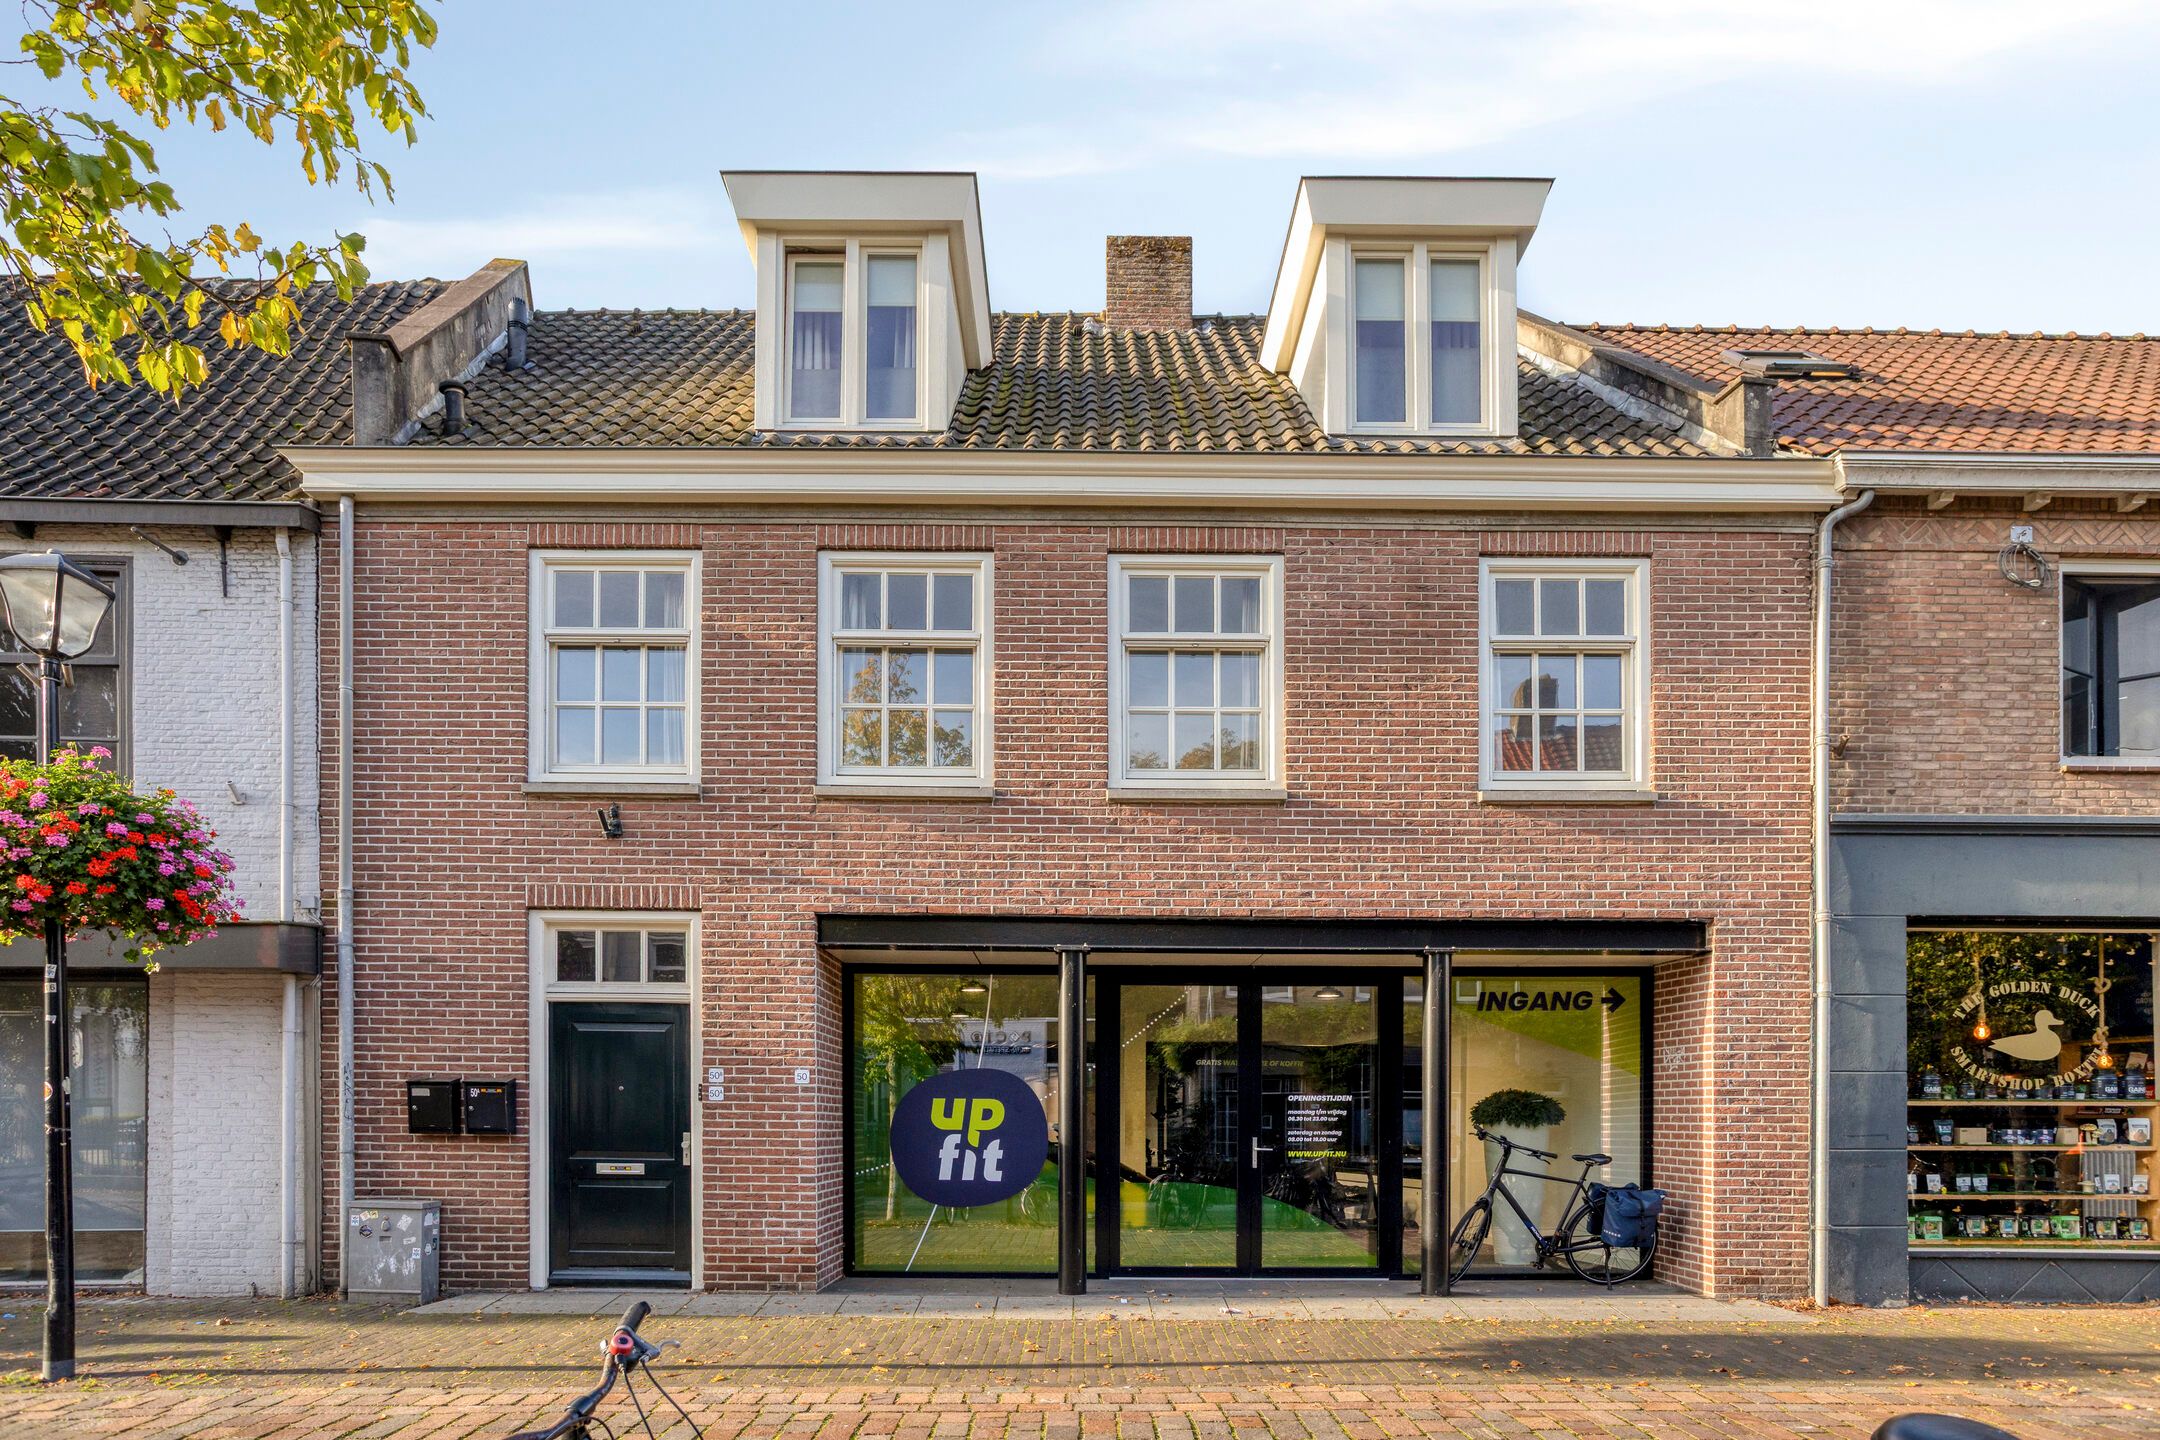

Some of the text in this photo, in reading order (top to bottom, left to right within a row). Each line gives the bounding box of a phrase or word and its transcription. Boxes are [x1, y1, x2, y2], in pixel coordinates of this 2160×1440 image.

[1477, 991, 1593, 1012] INGANG
[1953, 981, 2100, 1019] THE GOLDEN DUCK
[796, 1072, 808, 1081] 50
[1951, 1046, 2045, 1090] SMARTSHOP
[1287, 1094, 1353, 1102] OPENINGSTIJDEN
[931, 1097, 1005, 1148] up
[1316, 1108, 1327, 1116] t/m
[938, 1133, 1004, 1182] fit
[1287, 1150, 1347, 1158] WWW.UPFIT.NU
